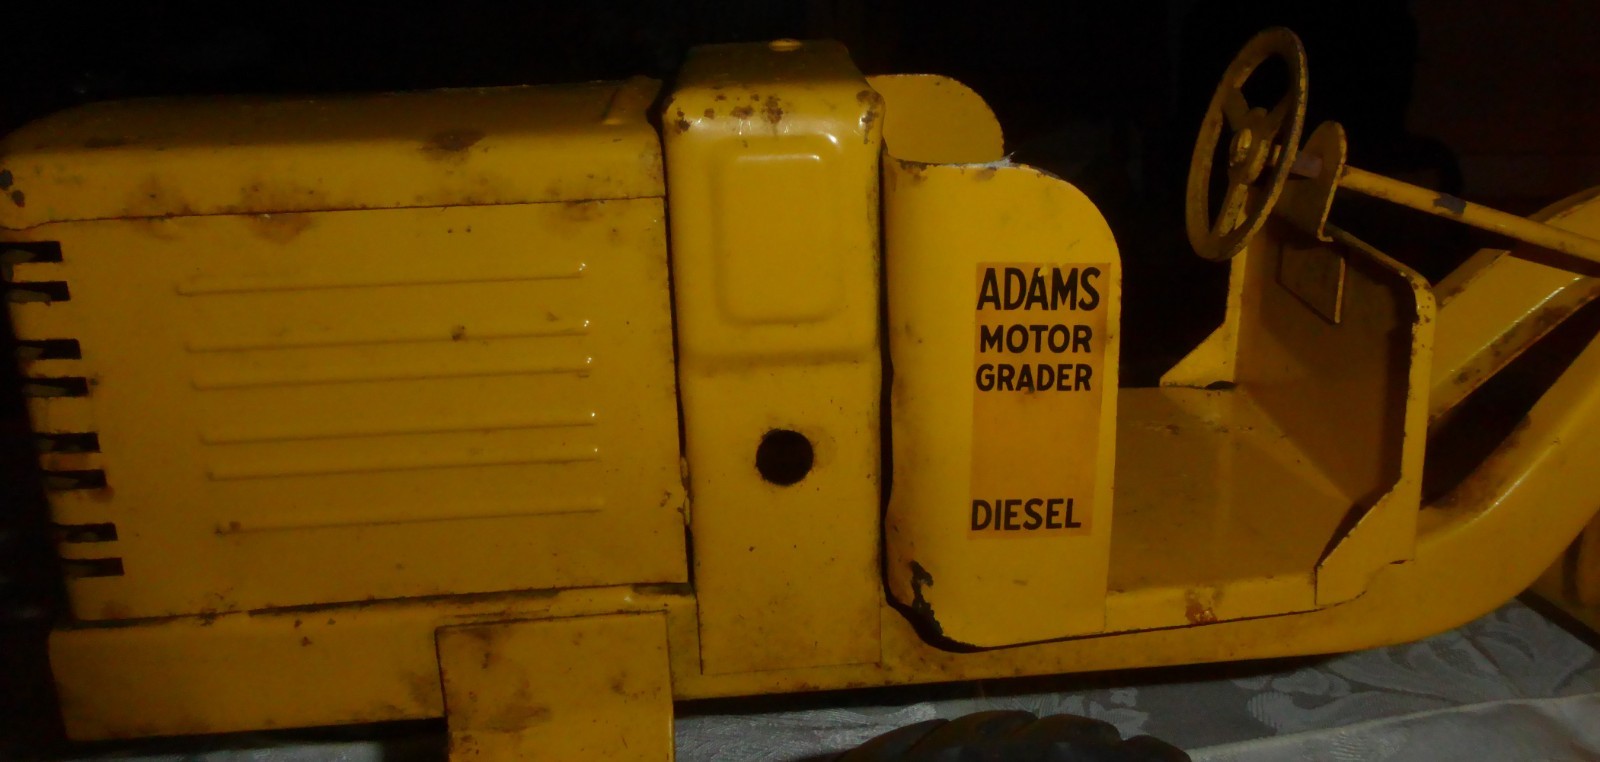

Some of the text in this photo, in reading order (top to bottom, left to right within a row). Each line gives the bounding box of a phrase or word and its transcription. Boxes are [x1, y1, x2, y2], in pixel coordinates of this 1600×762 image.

[976, 267, 1101, 311] ADAMS
[980, 324, 1093, 354] MOTOR
[975, 363, 1093, 392] GRADER
[971, 498, 1082, 531] DIESEL
